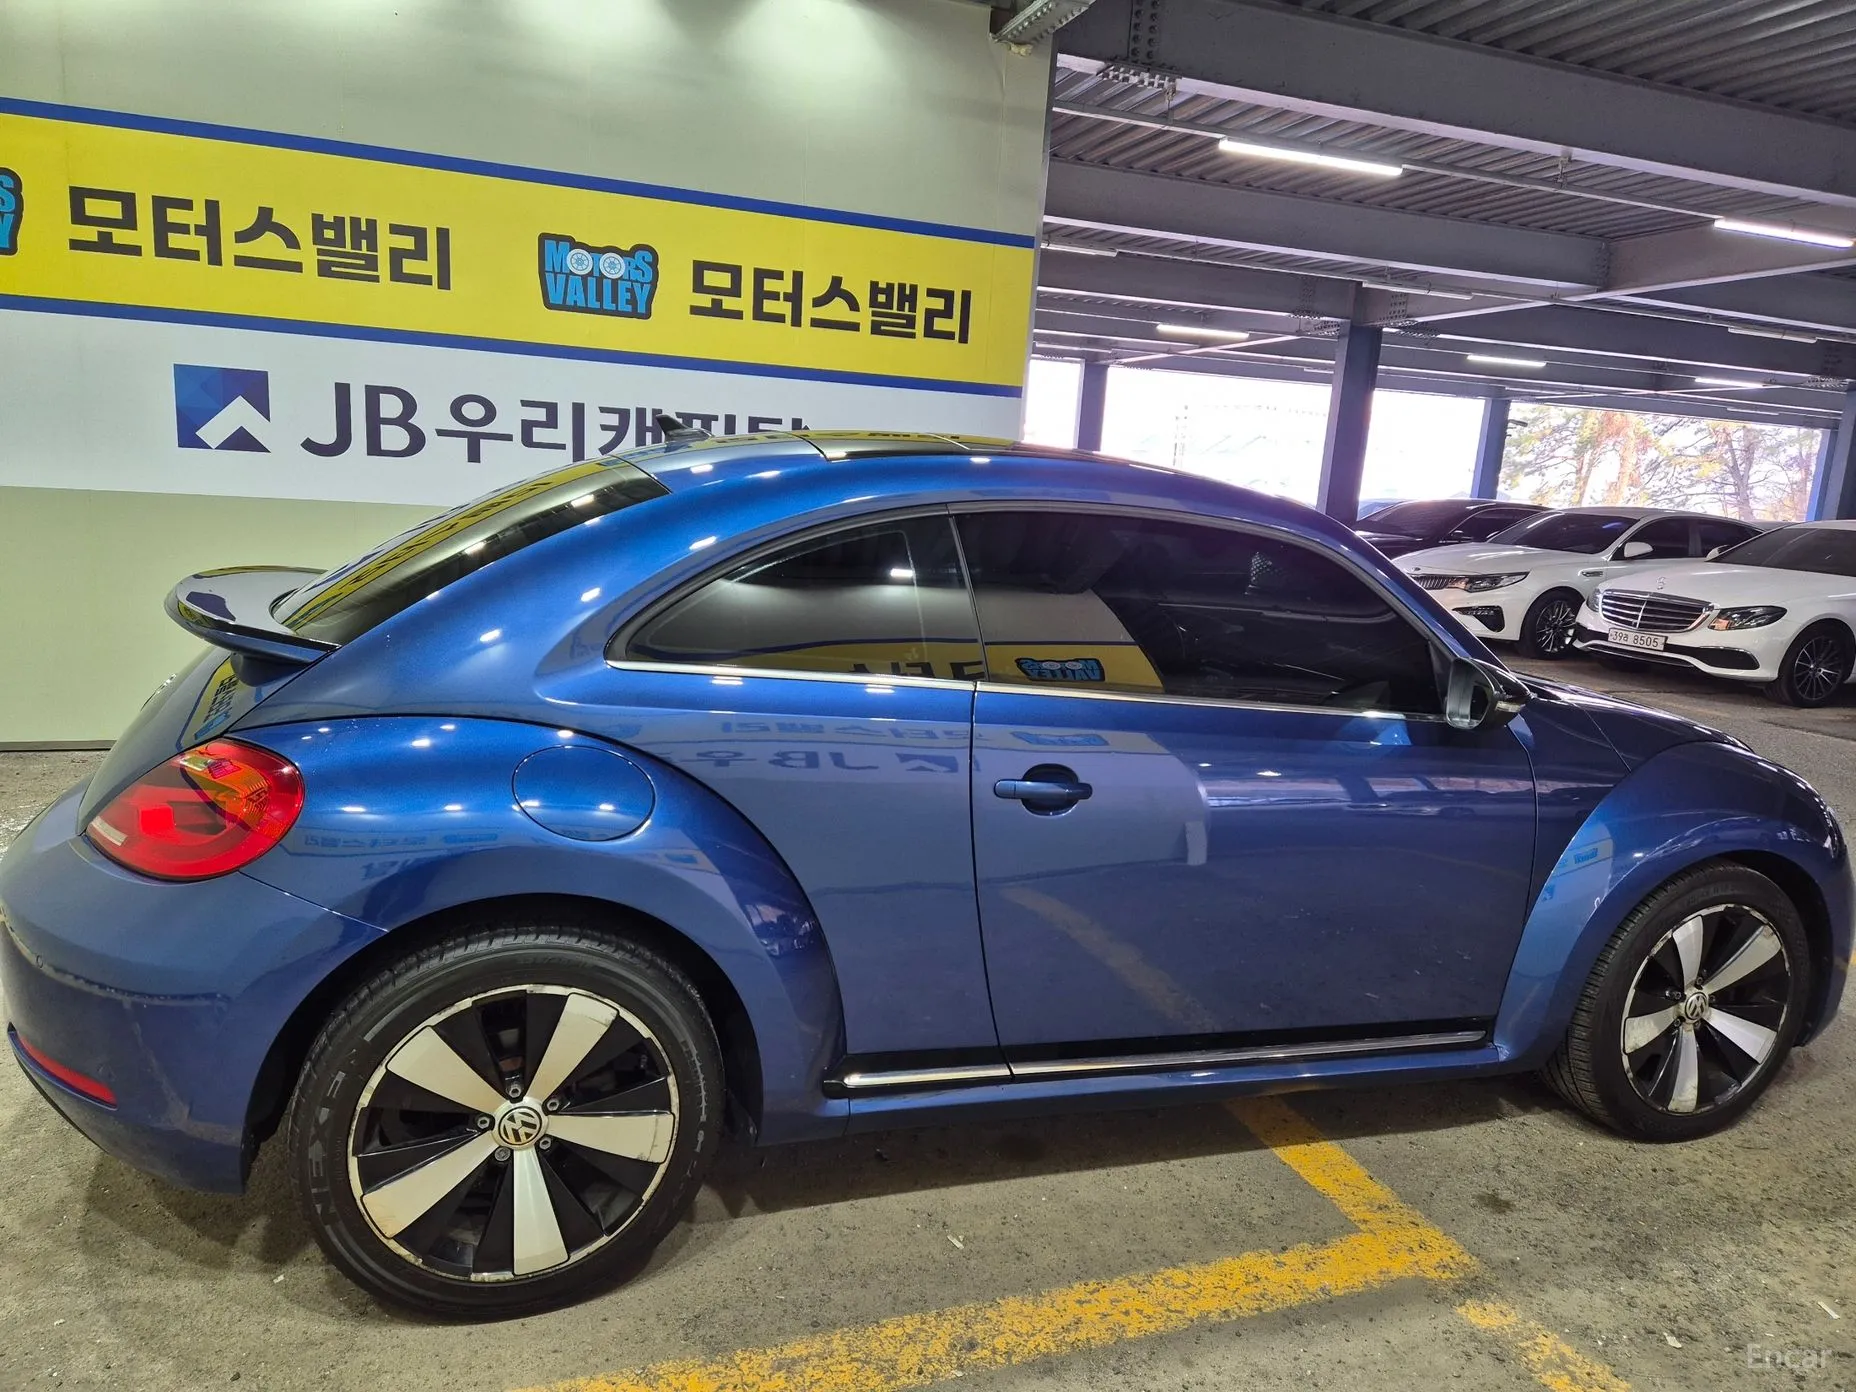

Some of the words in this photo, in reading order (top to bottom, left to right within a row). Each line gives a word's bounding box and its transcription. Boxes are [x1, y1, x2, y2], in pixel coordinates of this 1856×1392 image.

[68, 185, 452, 291] 모터스밸리
[544, 239, 653, 283] MOTORS
[545, 271, 652, 314] VALLEY
[689, 259, 972, 345] 모터스밸리
[300, 381, 810, 463] JB우리캐
[1632, 634, 1659, 648] 8505
